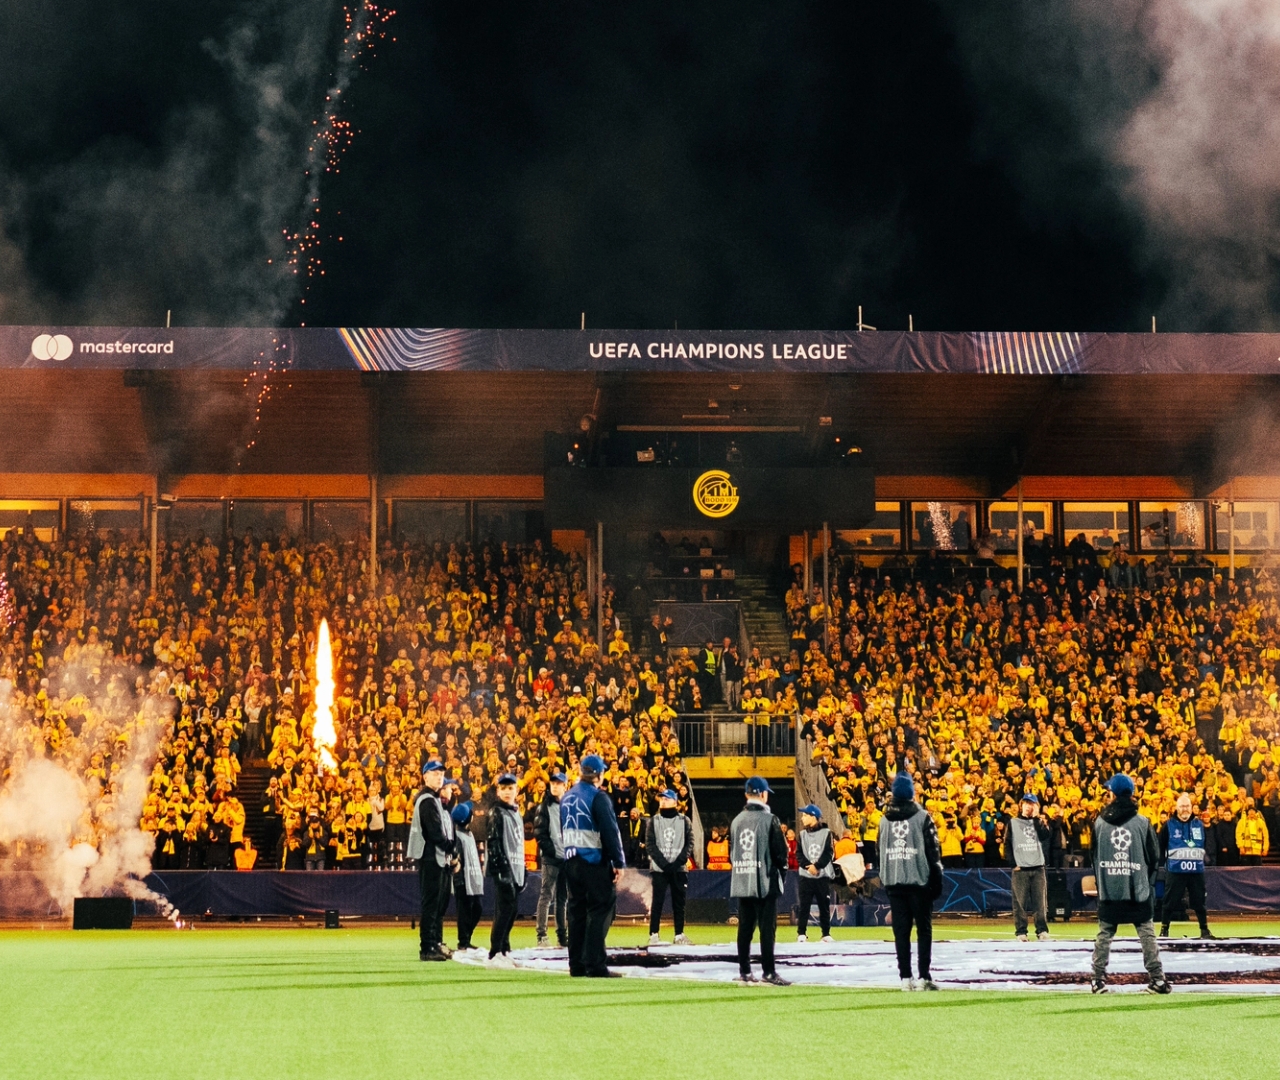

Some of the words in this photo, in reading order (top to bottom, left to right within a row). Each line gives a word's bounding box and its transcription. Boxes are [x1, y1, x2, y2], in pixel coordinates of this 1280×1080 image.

[80, 340, 174, 353] mastercard
[589, 342, 641, 358] UEFA
[647, 343, 764, 359] CHAMPIONS
[772, 344, 848, 360] LEAGUE
[1176, 850, 1202, 858] PITCH
[1181, 861, 1197, 870] 001
